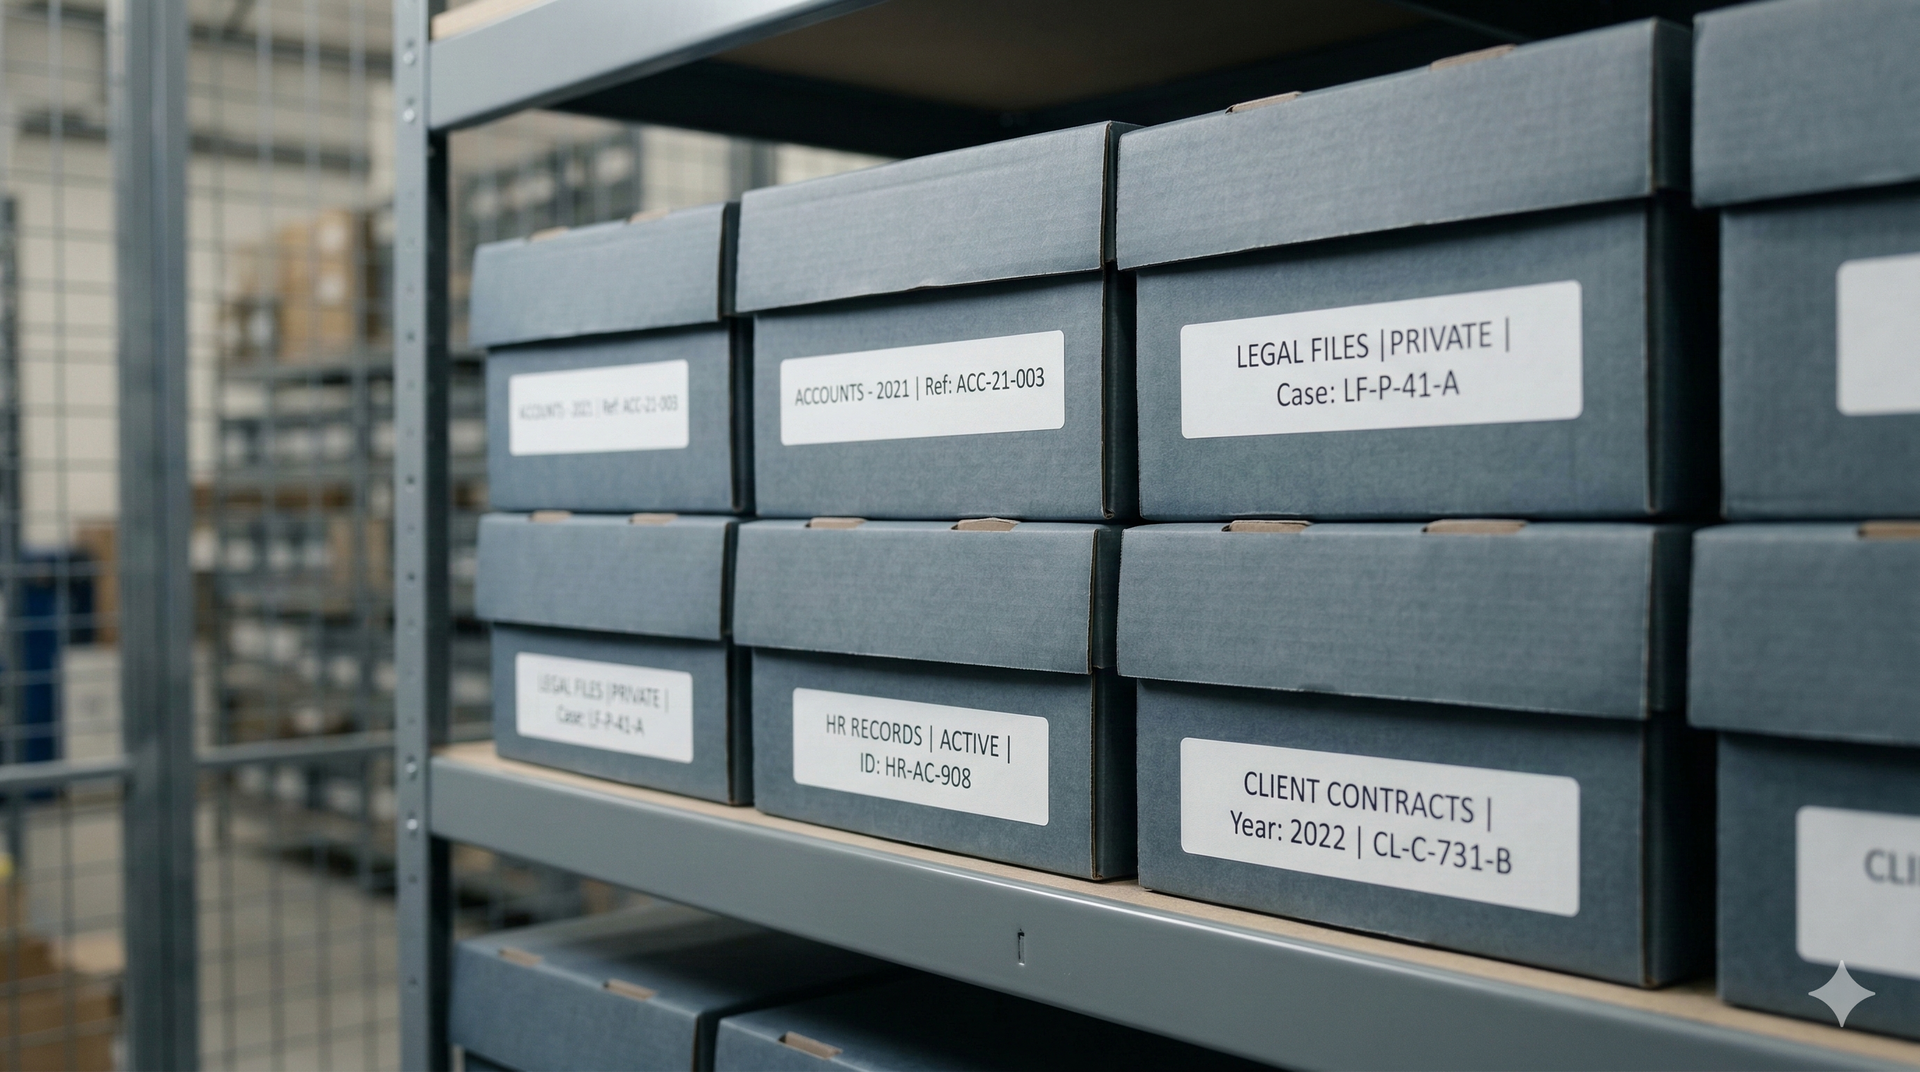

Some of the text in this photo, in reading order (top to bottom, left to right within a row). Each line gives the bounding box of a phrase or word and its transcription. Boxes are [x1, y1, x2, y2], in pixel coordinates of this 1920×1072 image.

[1238, 340, 1304, 368] LEGAL
[1312, 333, 1369, 362] FILES
[795, 383, 864, 405] ACCOUNTS
[877, 379, 909, 399] 2021
[926, 374, 951, 395] Ref:
[957, 367, 1044, 393] ACC-21-003
[1277, 370, 1459, 406] Case: LF-P-41-A
[827, 715, 846, 735] HR
[852, 718, 922, 746] RECORDS
[940, 729, 999, 757] ACTIVE
[861, 753, 971, 789] ID: HR-AC-908
[1244, 771, 1320, 803] CLIENT
[1327, 782, 1474, 823] CONTRACTS
[1230, 810, 1282, 841] Year:
[1291, 819, 1345, 850] 2022
[1374, 829, 1512, 874] CL-C-731-B
[1863, 848, 1920, 886] CLI
